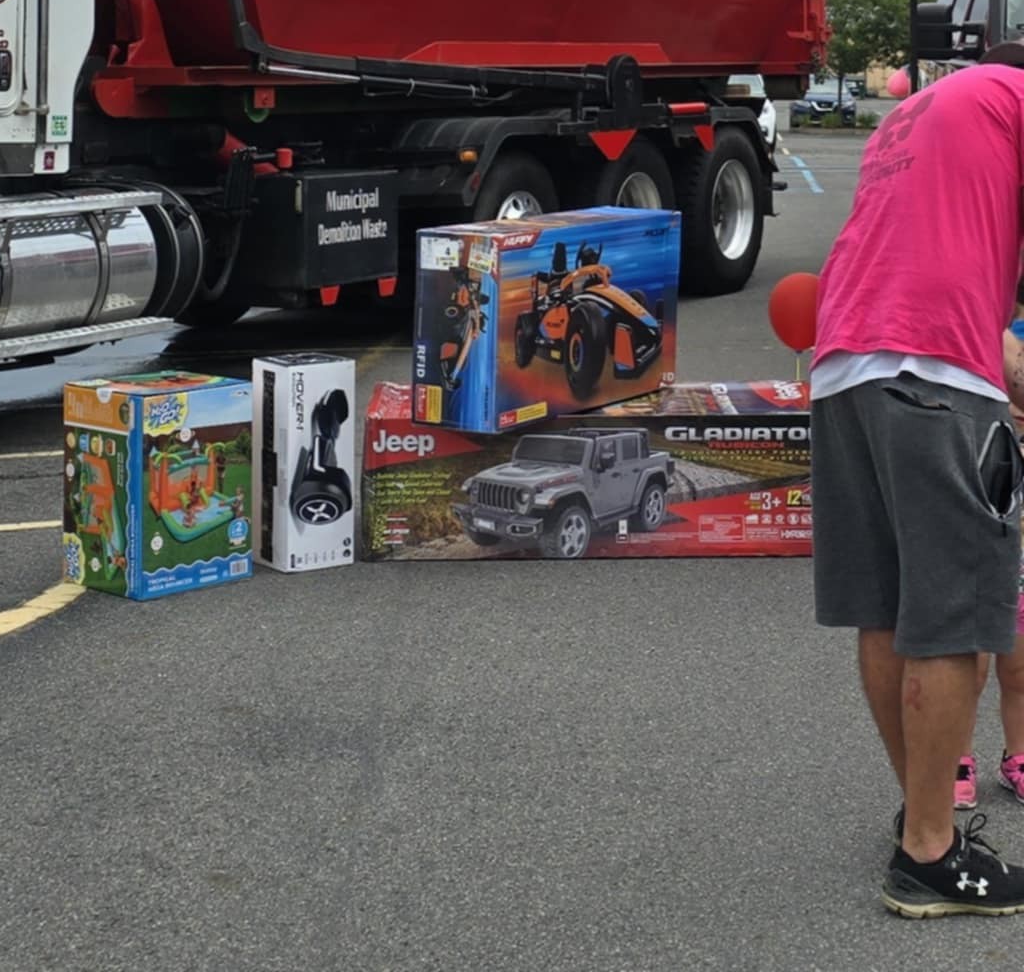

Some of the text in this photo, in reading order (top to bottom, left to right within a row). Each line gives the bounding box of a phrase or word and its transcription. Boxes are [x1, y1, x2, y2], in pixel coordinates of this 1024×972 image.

[326, 186, 380, 214] Municipal
[416, 344, 427, 379] RFID
[372, 429, 436, 457] Jeep
[664, 427, 811, 441] GLADIATO
[787, 489, 803, 506] 12
